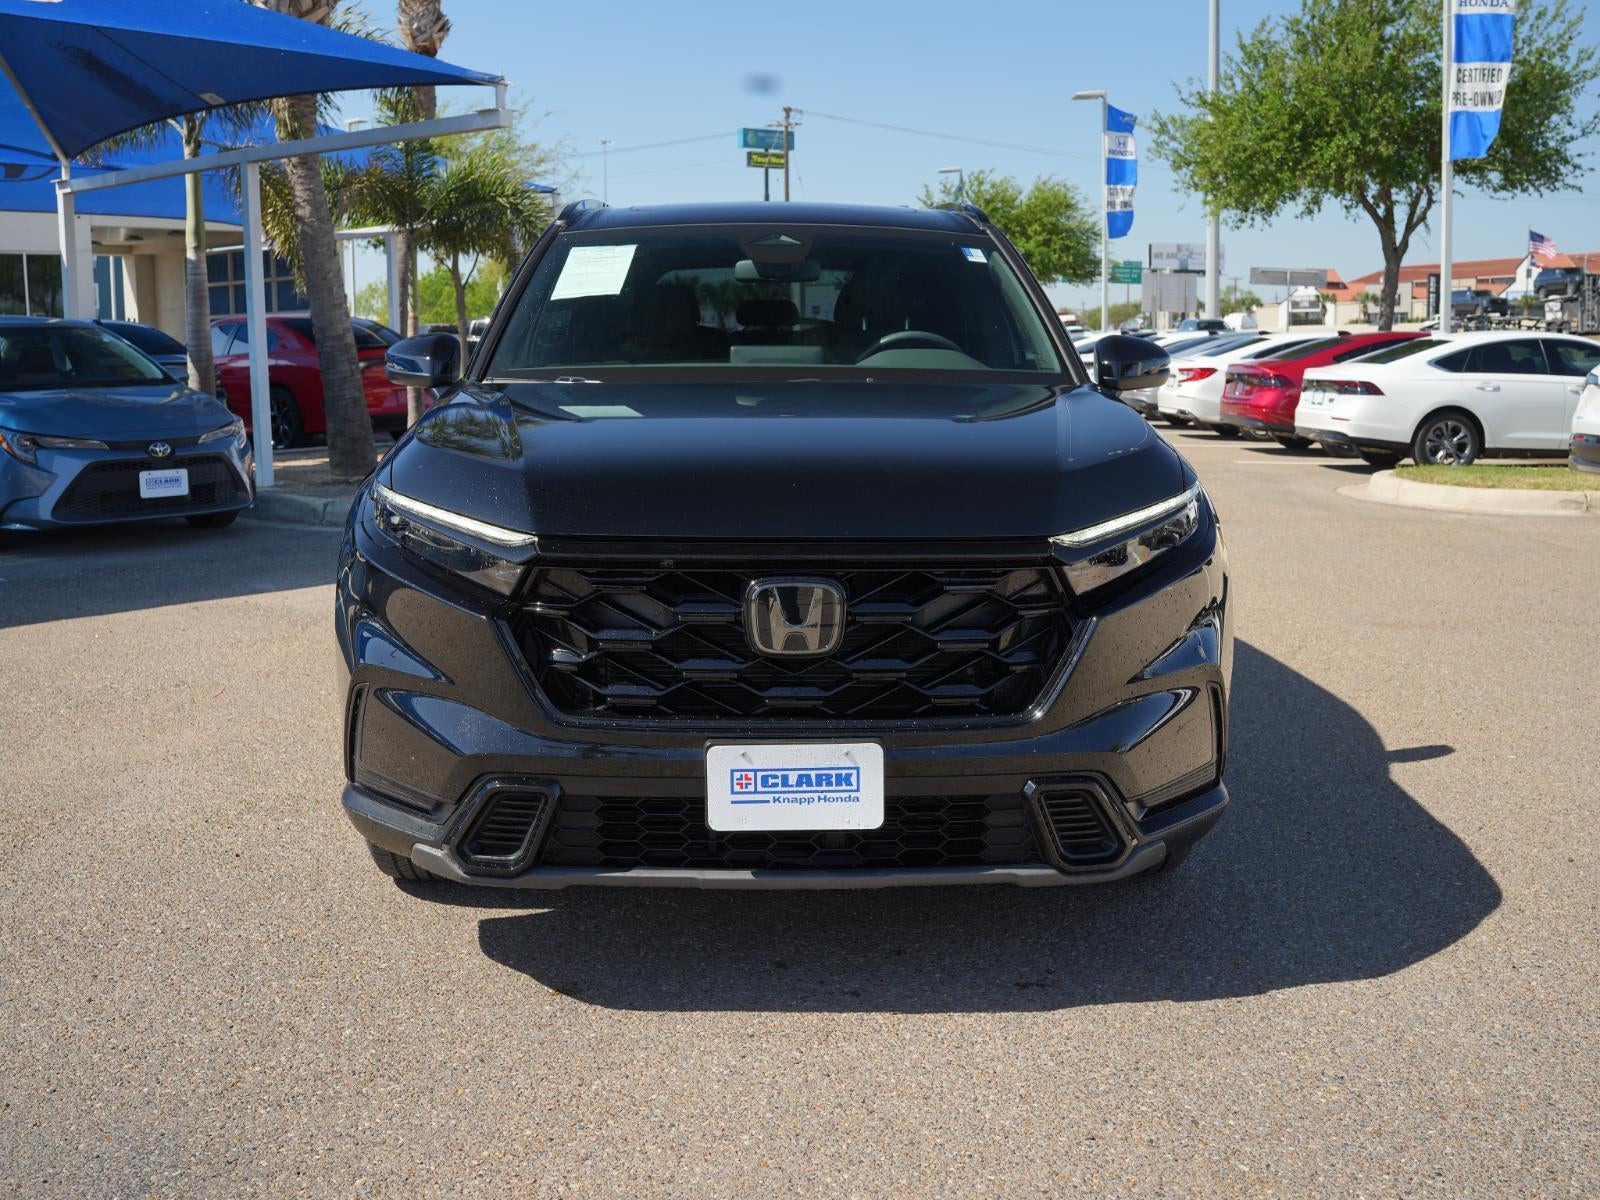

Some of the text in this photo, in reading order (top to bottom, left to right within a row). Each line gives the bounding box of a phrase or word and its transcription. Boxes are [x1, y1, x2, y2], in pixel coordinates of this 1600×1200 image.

[1459, 0, 1509, 8] HONDA
[1456, 67, 1503, 84] CERTIFIED
[760, 773, 854, 788] CLARK
[772, 795, 860, 805] Knapp Honda
